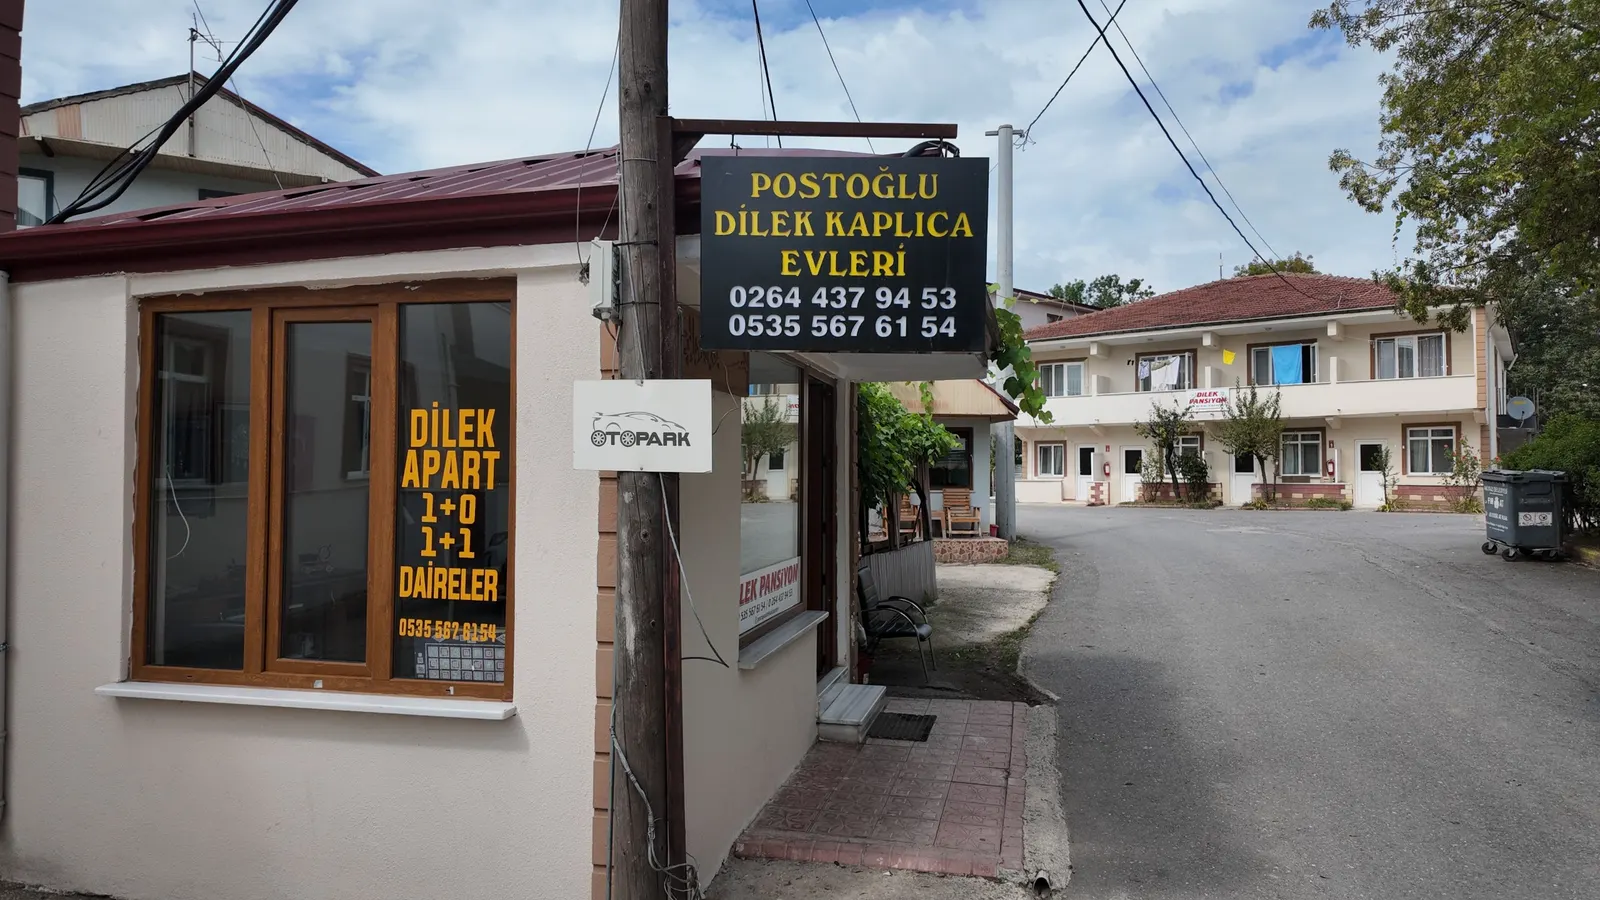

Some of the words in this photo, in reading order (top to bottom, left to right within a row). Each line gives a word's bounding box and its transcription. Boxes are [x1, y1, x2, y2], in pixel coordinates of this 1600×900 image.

[751, 166, 939, 200] POSTOĞLU
[714, 204, 815, 238] DİLEK
[825, 211, 974, 239] KAPLICA
[781, 242, 906, 278] EVLERİ
[729, 285, 801, 309] 0264
[811, 286, 866, 309] 437
[875, 286, 911, 310] 94
[920, 287, 957, 310] 53
[728, 314, 801, 337] 0535
[811, 315, 865, 338] 567
[875, 315, 907, 338] 61
[920, 316, 957, 338] 54
[410, 401, 496, 448] DİLEK
[590, 430, 691, 447] OTOPARK
[401, 449, 501, 490] APART
[421, 492, 477, 525] 1+0
[420, 526, 475, 559] 1+1
[399, 560, 499, 602] DAİRELER
[398, 618, 432, 638] 0535
[434, 620, 460, 640] 567
[462, 622, 497, 643] 6154
